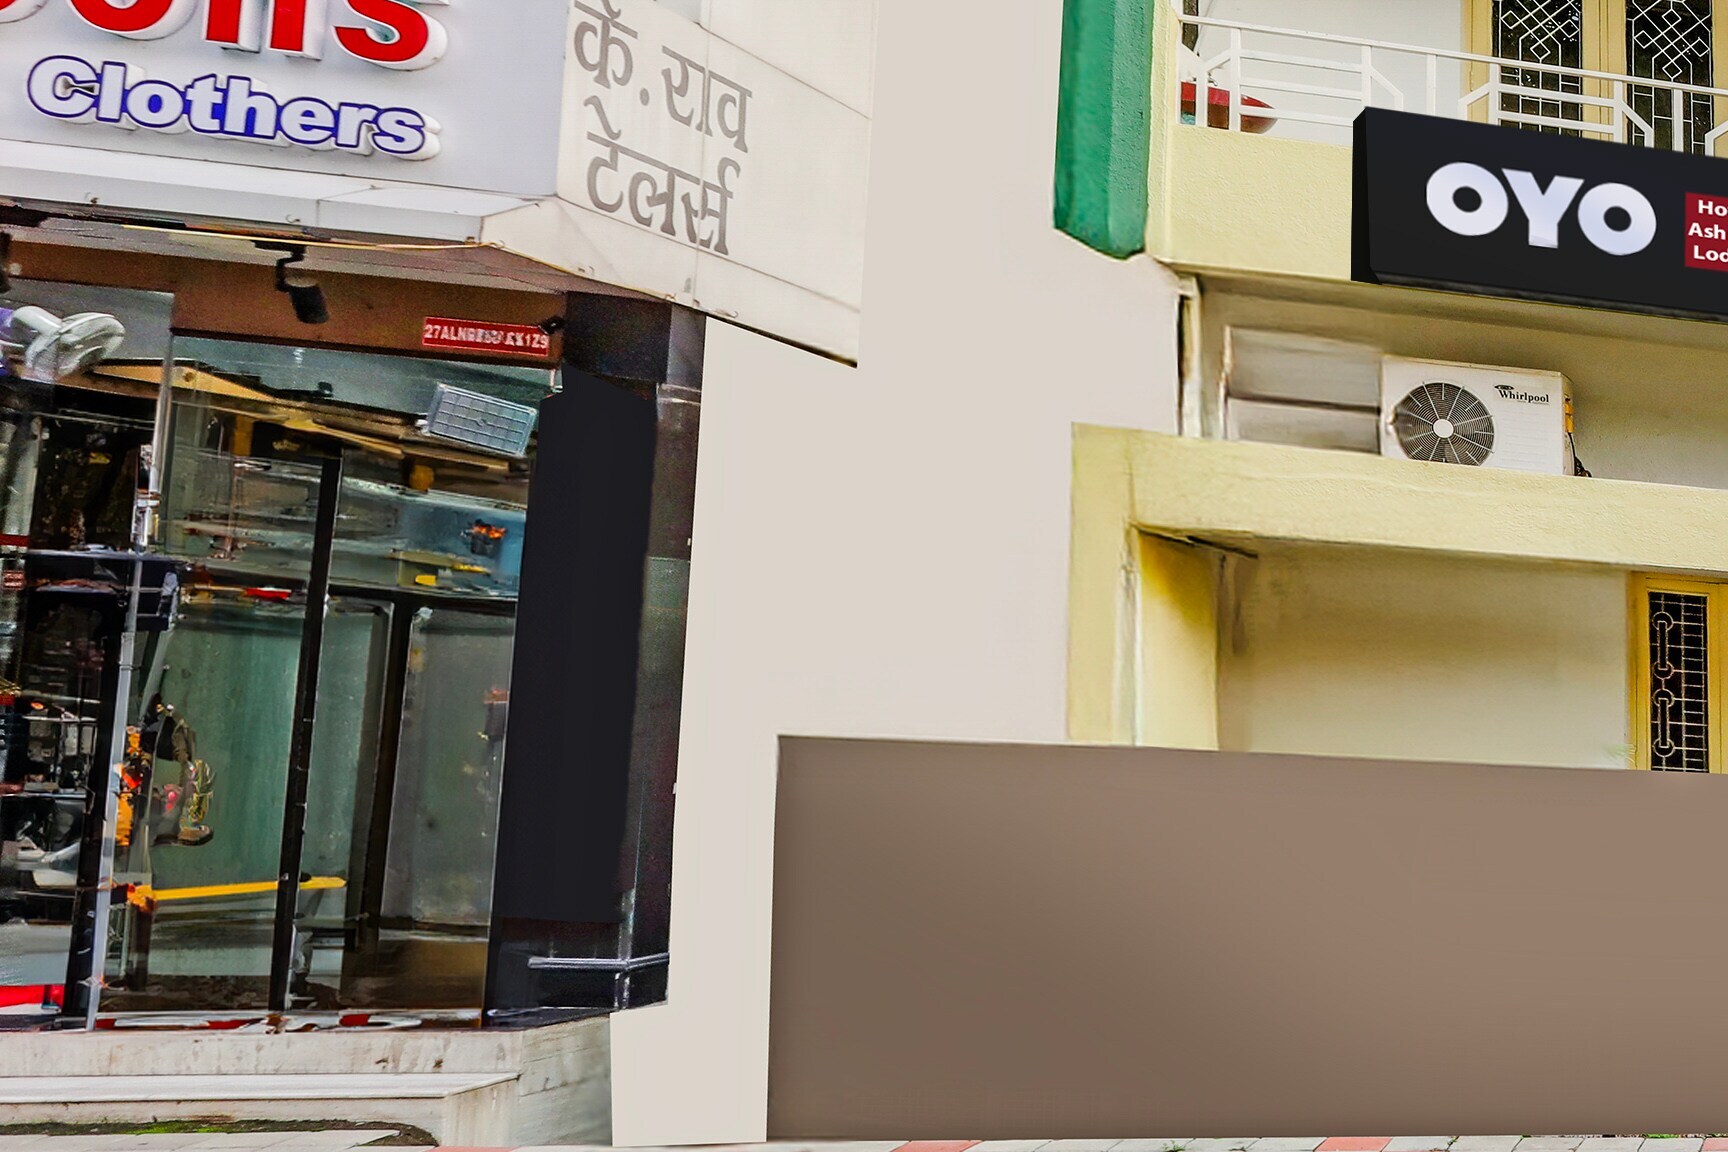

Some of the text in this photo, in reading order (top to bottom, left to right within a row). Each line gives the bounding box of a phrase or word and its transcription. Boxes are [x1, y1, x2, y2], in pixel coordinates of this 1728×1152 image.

[27, 55, 428, 155] Clothers
[584, 96, 740, 256] टेलर्स
[1426, 162, 1657, 255] OYO
[1499, 389, 1549, 403] Whirlpool
